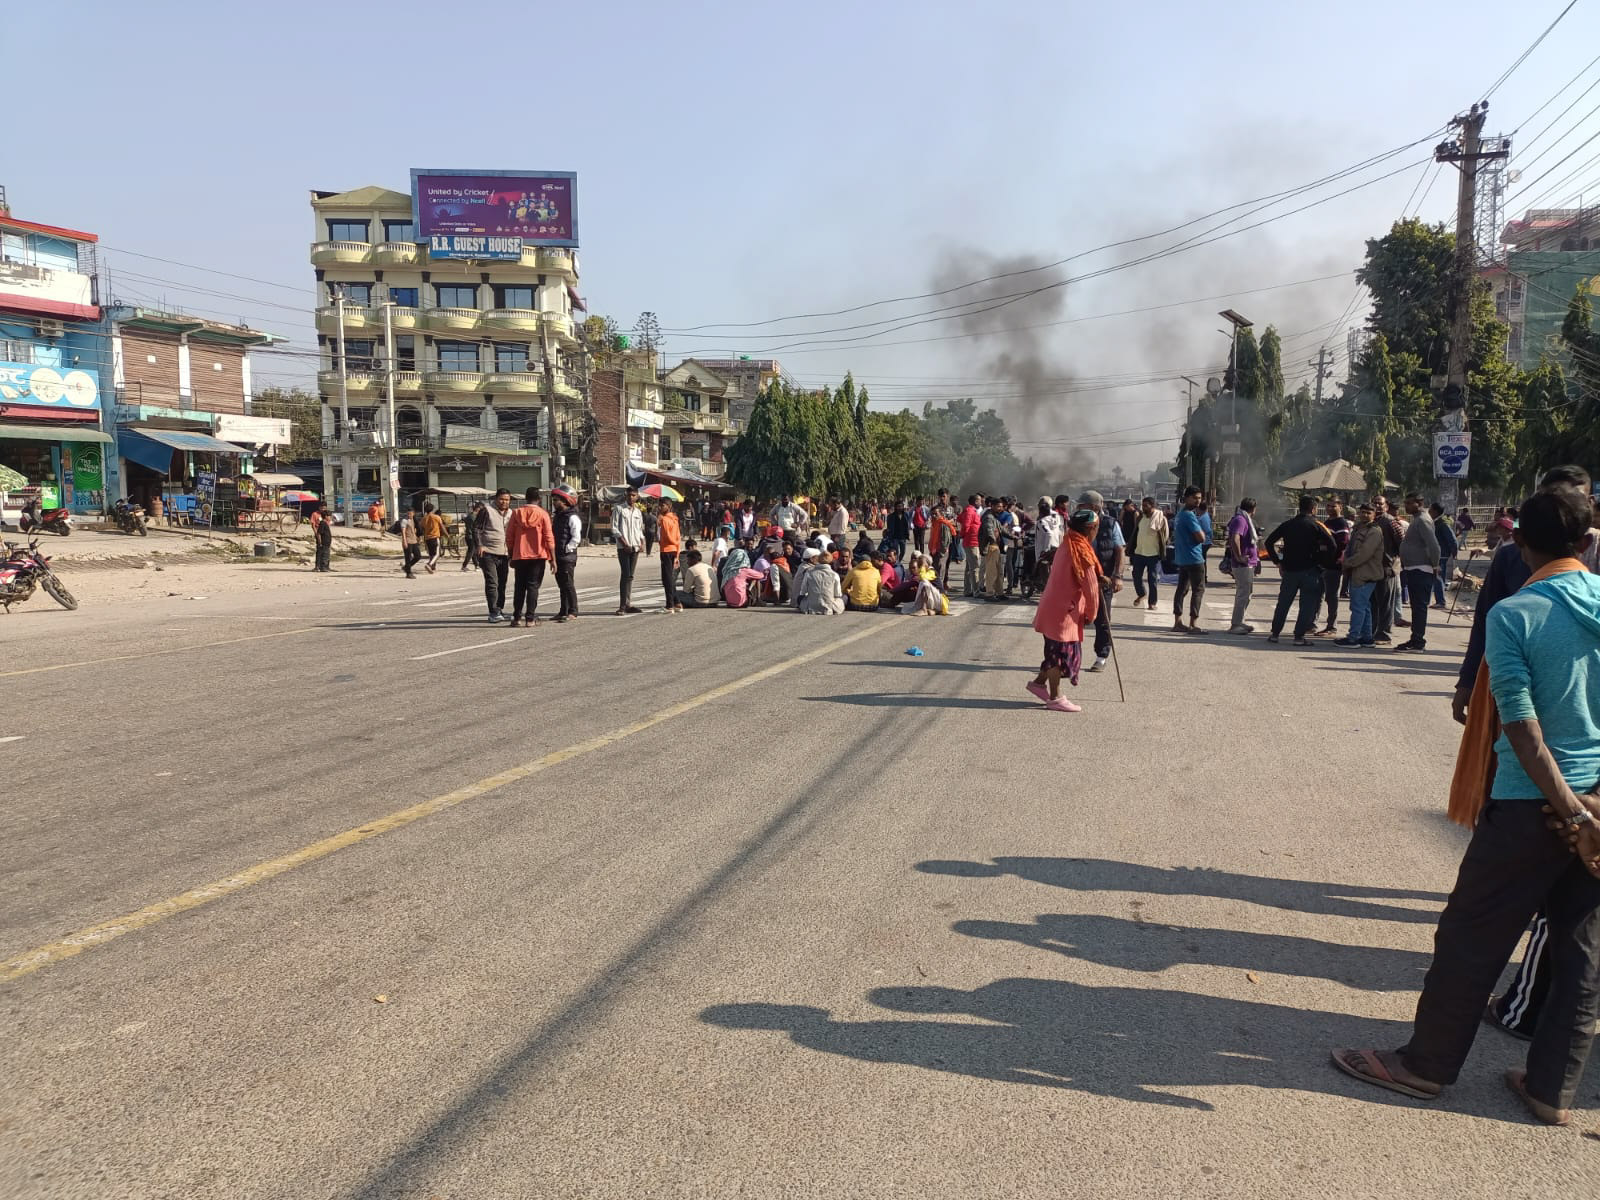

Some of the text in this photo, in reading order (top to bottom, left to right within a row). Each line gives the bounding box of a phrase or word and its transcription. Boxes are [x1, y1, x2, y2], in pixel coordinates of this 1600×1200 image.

[431, 236, 521, 253] R.R. GUEST HOUSE
